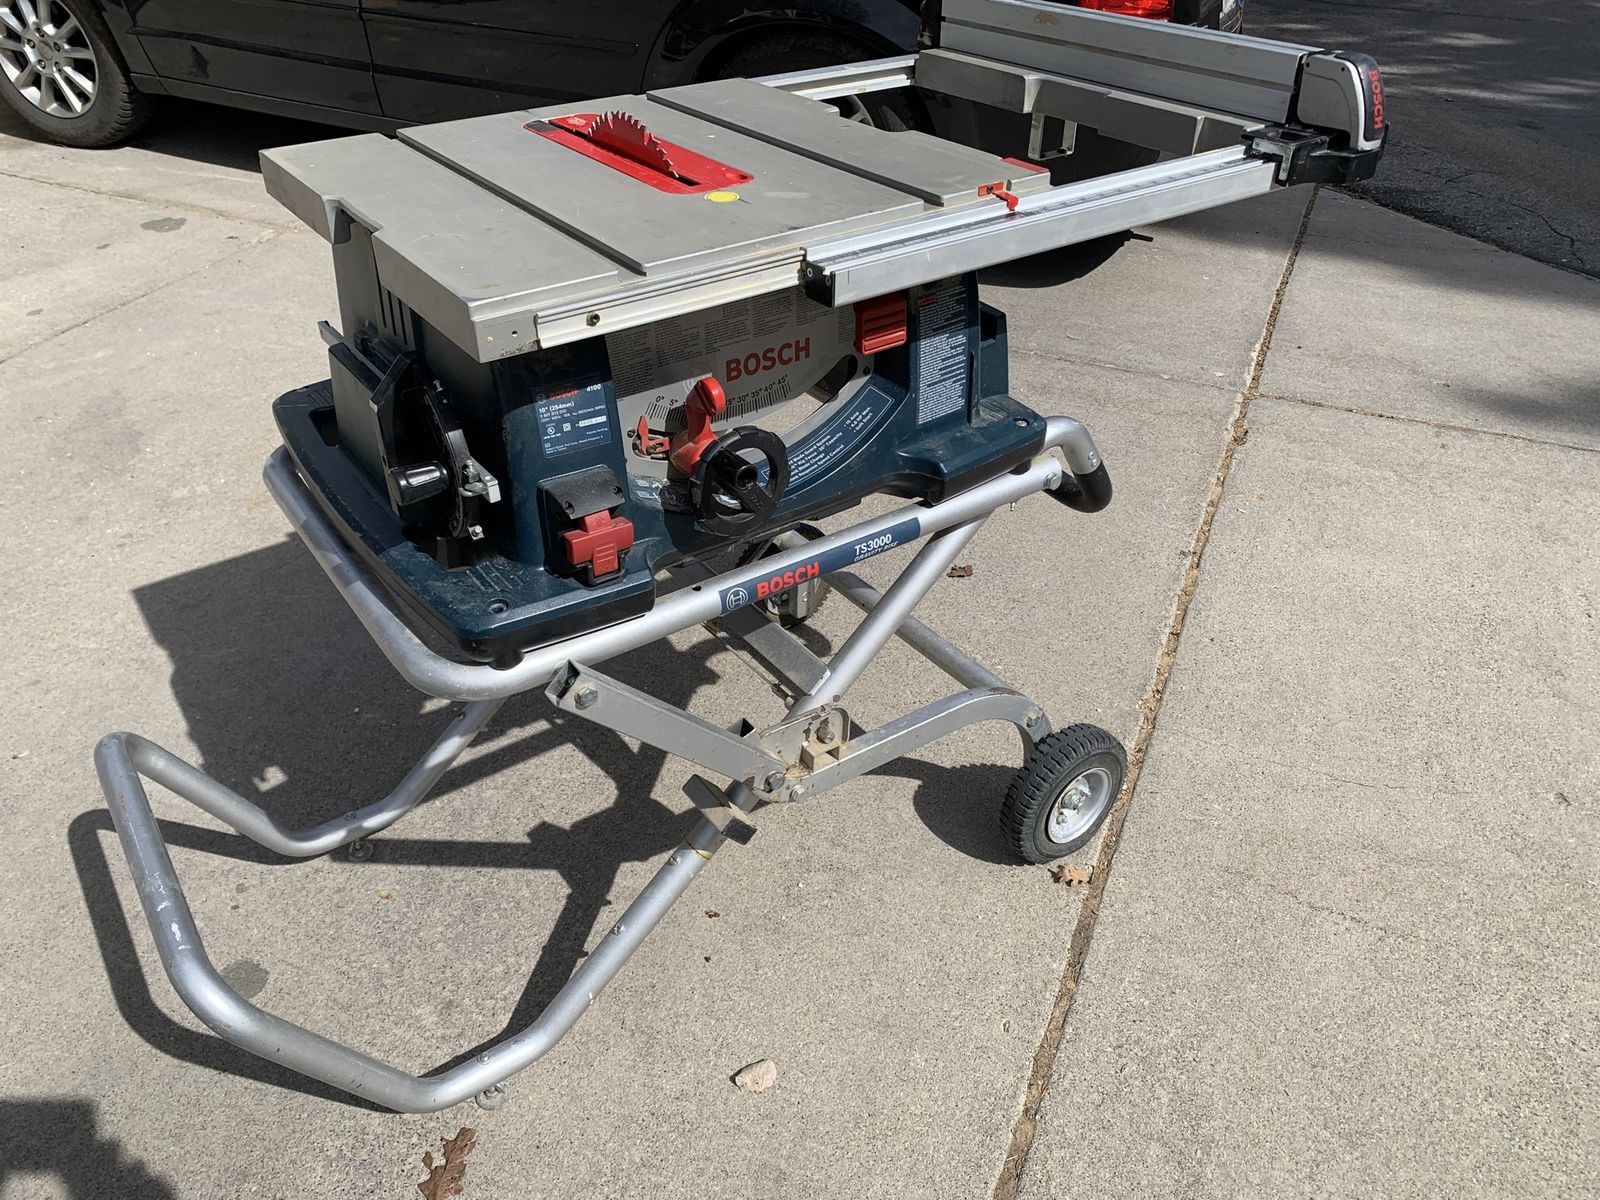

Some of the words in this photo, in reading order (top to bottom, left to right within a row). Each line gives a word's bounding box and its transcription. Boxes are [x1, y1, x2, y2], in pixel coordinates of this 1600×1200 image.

[1368, 69, 1384, 129] BOSCH
[725, 336, 811, 383] BOSCH
[586, 383, 602, 392] 4100
[655, 395, 665, 403] 0°
[737, 394, 749, 402] 30°
[750, 388, 762, 398] 35°
[763, 381, 776, 392] 40°
[776, 374, 788, 385] 45°
[549, 400, 575, 411] (254mm)
[850, 411, 860, 420] Amp
[856, 414, 863, 422] HP
[862, 412, 873, 423] Start
[804, 445, 817, 455] Guard
[816, 435, 831, 447] System
[805, 452, 817, 460] Fence
[825, 432, 843, 446] Capacity
[817, 455, 830, 466] Speed
[829, 444, 845, 457] Control
[810, 453, 825, 464] Change
[854, 533, 893, 555] TS3000
[853, 547, 883, 562] GRAVITY
[756, 561, 820, 599] BOSCH
